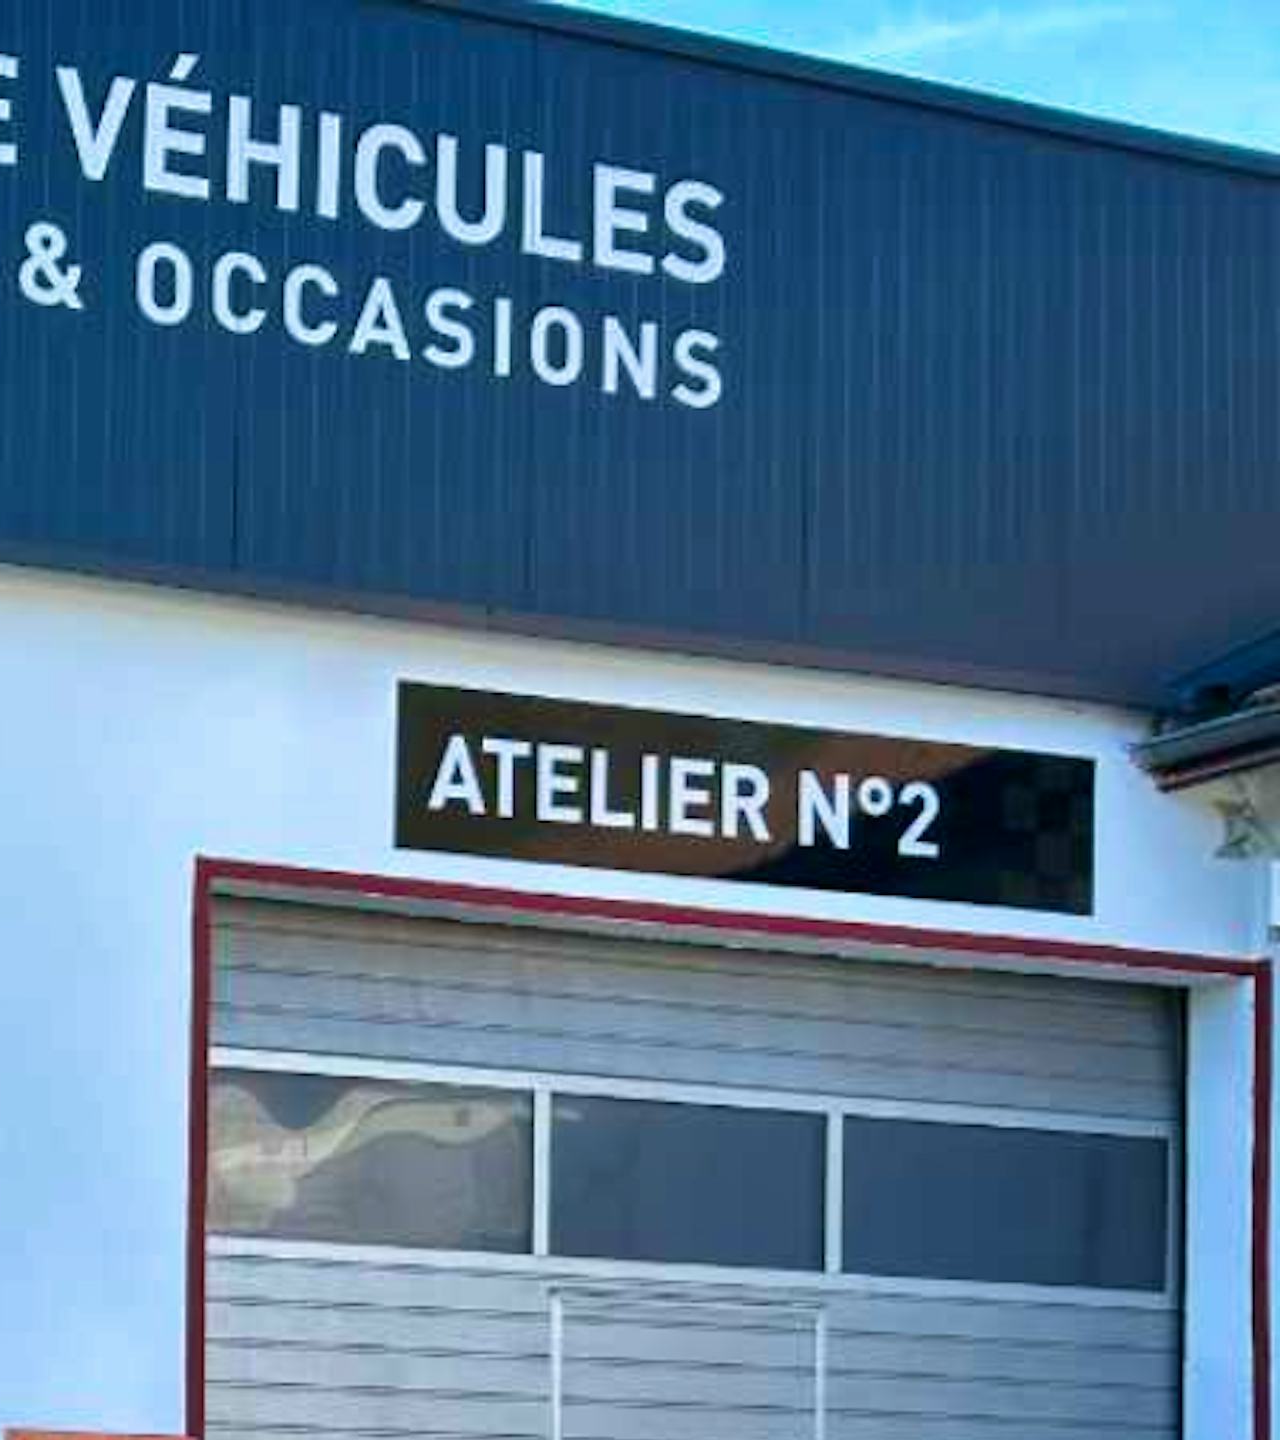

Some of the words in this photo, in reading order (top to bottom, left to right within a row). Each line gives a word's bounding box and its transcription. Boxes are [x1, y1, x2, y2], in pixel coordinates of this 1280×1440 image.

[56, 52, 727, 284] VÉHICULES
[18, 221, 83, 310] &
[136, 242, 723, 409] OCCASIONS
[427, 733, 772, 843] ATELIER
